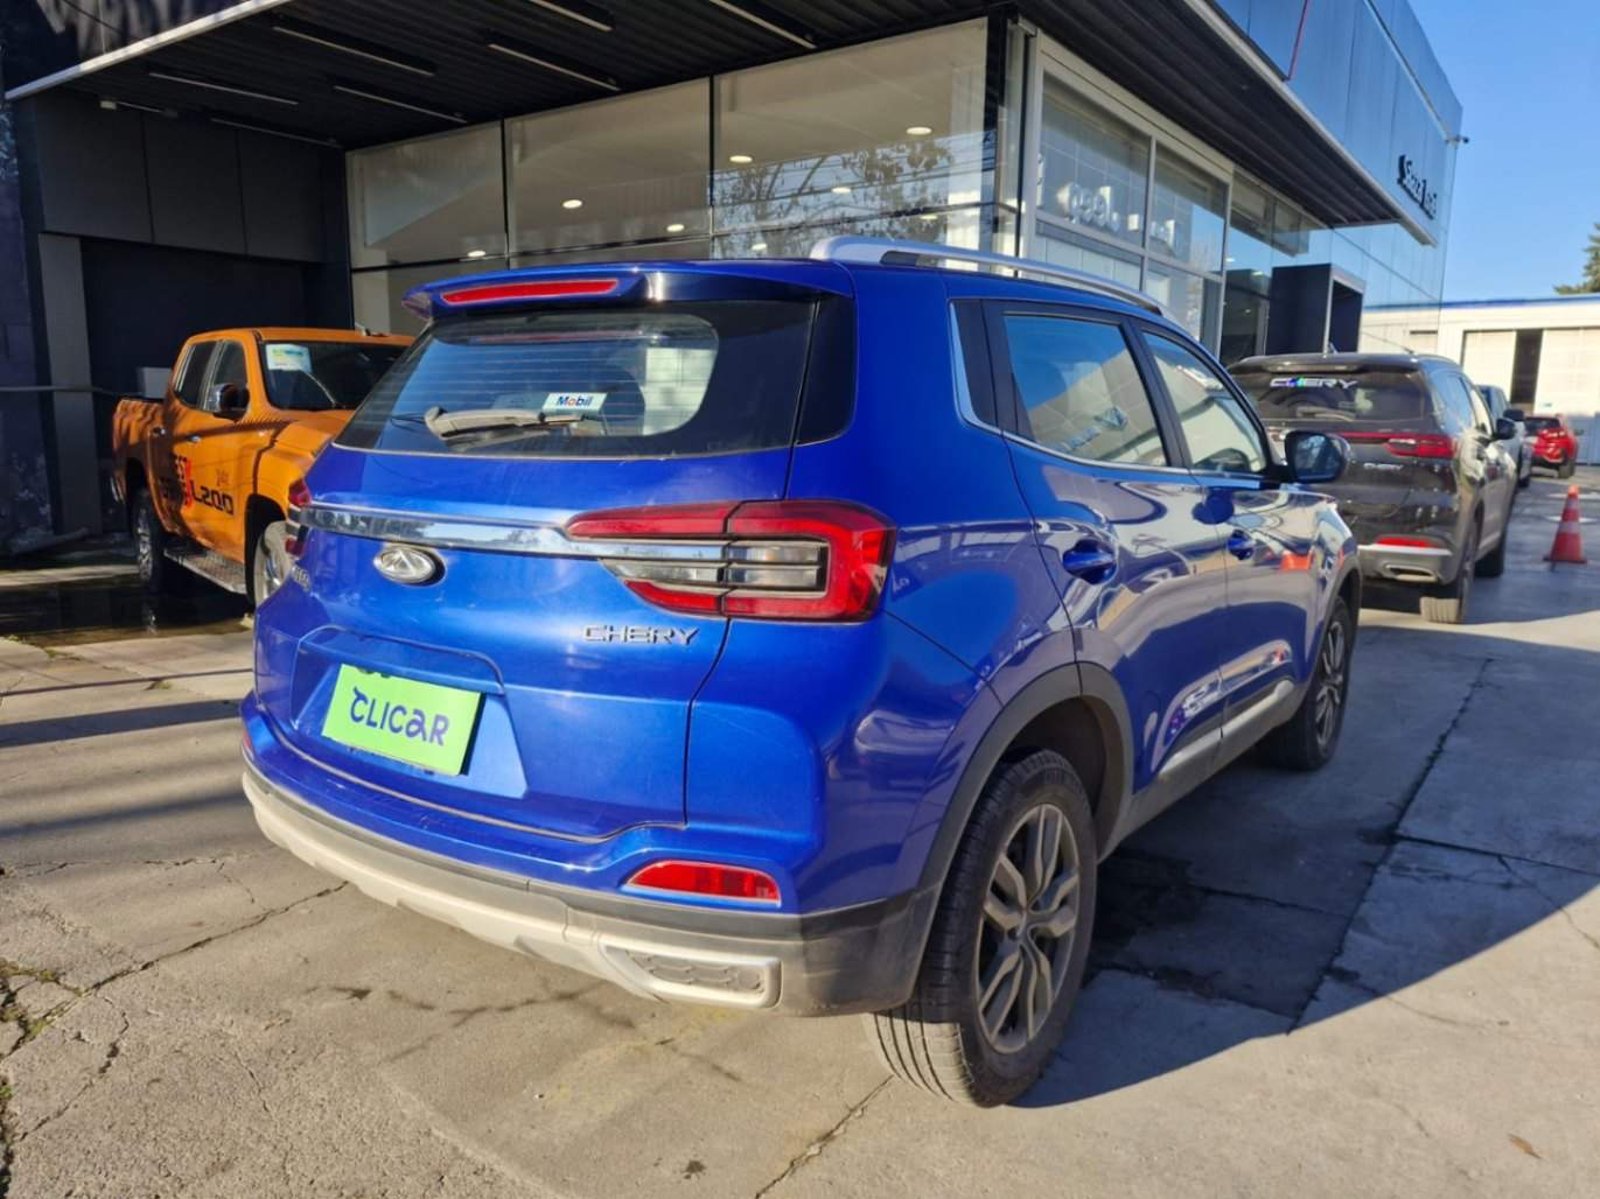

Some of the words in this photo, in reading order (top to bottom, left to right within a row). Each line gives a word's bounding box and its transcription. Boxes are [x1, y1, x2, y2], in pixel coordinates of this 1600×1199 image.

[1270, 377, 1358, 389] CHERY
[557, 396, 593, 406] Mobil
[190, 480, 234, 516] L200
[584, 625, 700, 645] CHERY
